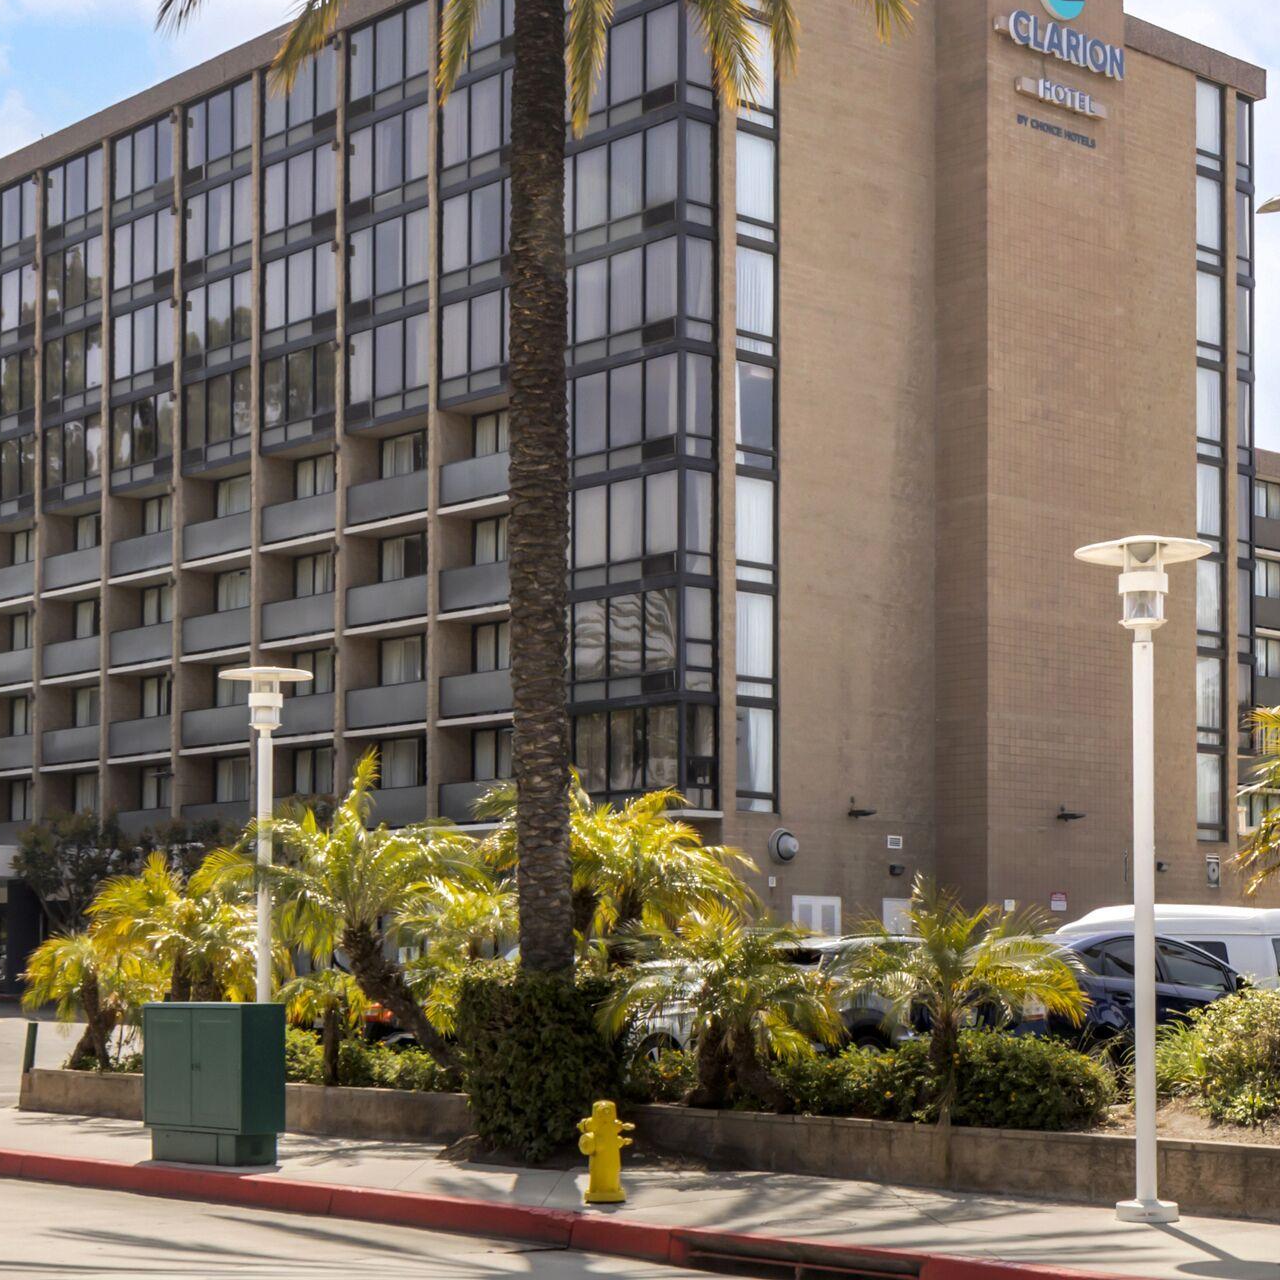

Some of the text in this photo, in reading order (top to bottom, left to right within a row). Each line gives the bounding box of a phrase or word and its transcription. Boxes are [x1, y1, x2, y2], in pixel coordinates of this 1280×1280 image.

[1009, 9, 1124, 81] CLARION
[1039, 78, 1096, 116] HOTEL
[1017, 114, 1096, 149] BY CHOICE HOTELS
